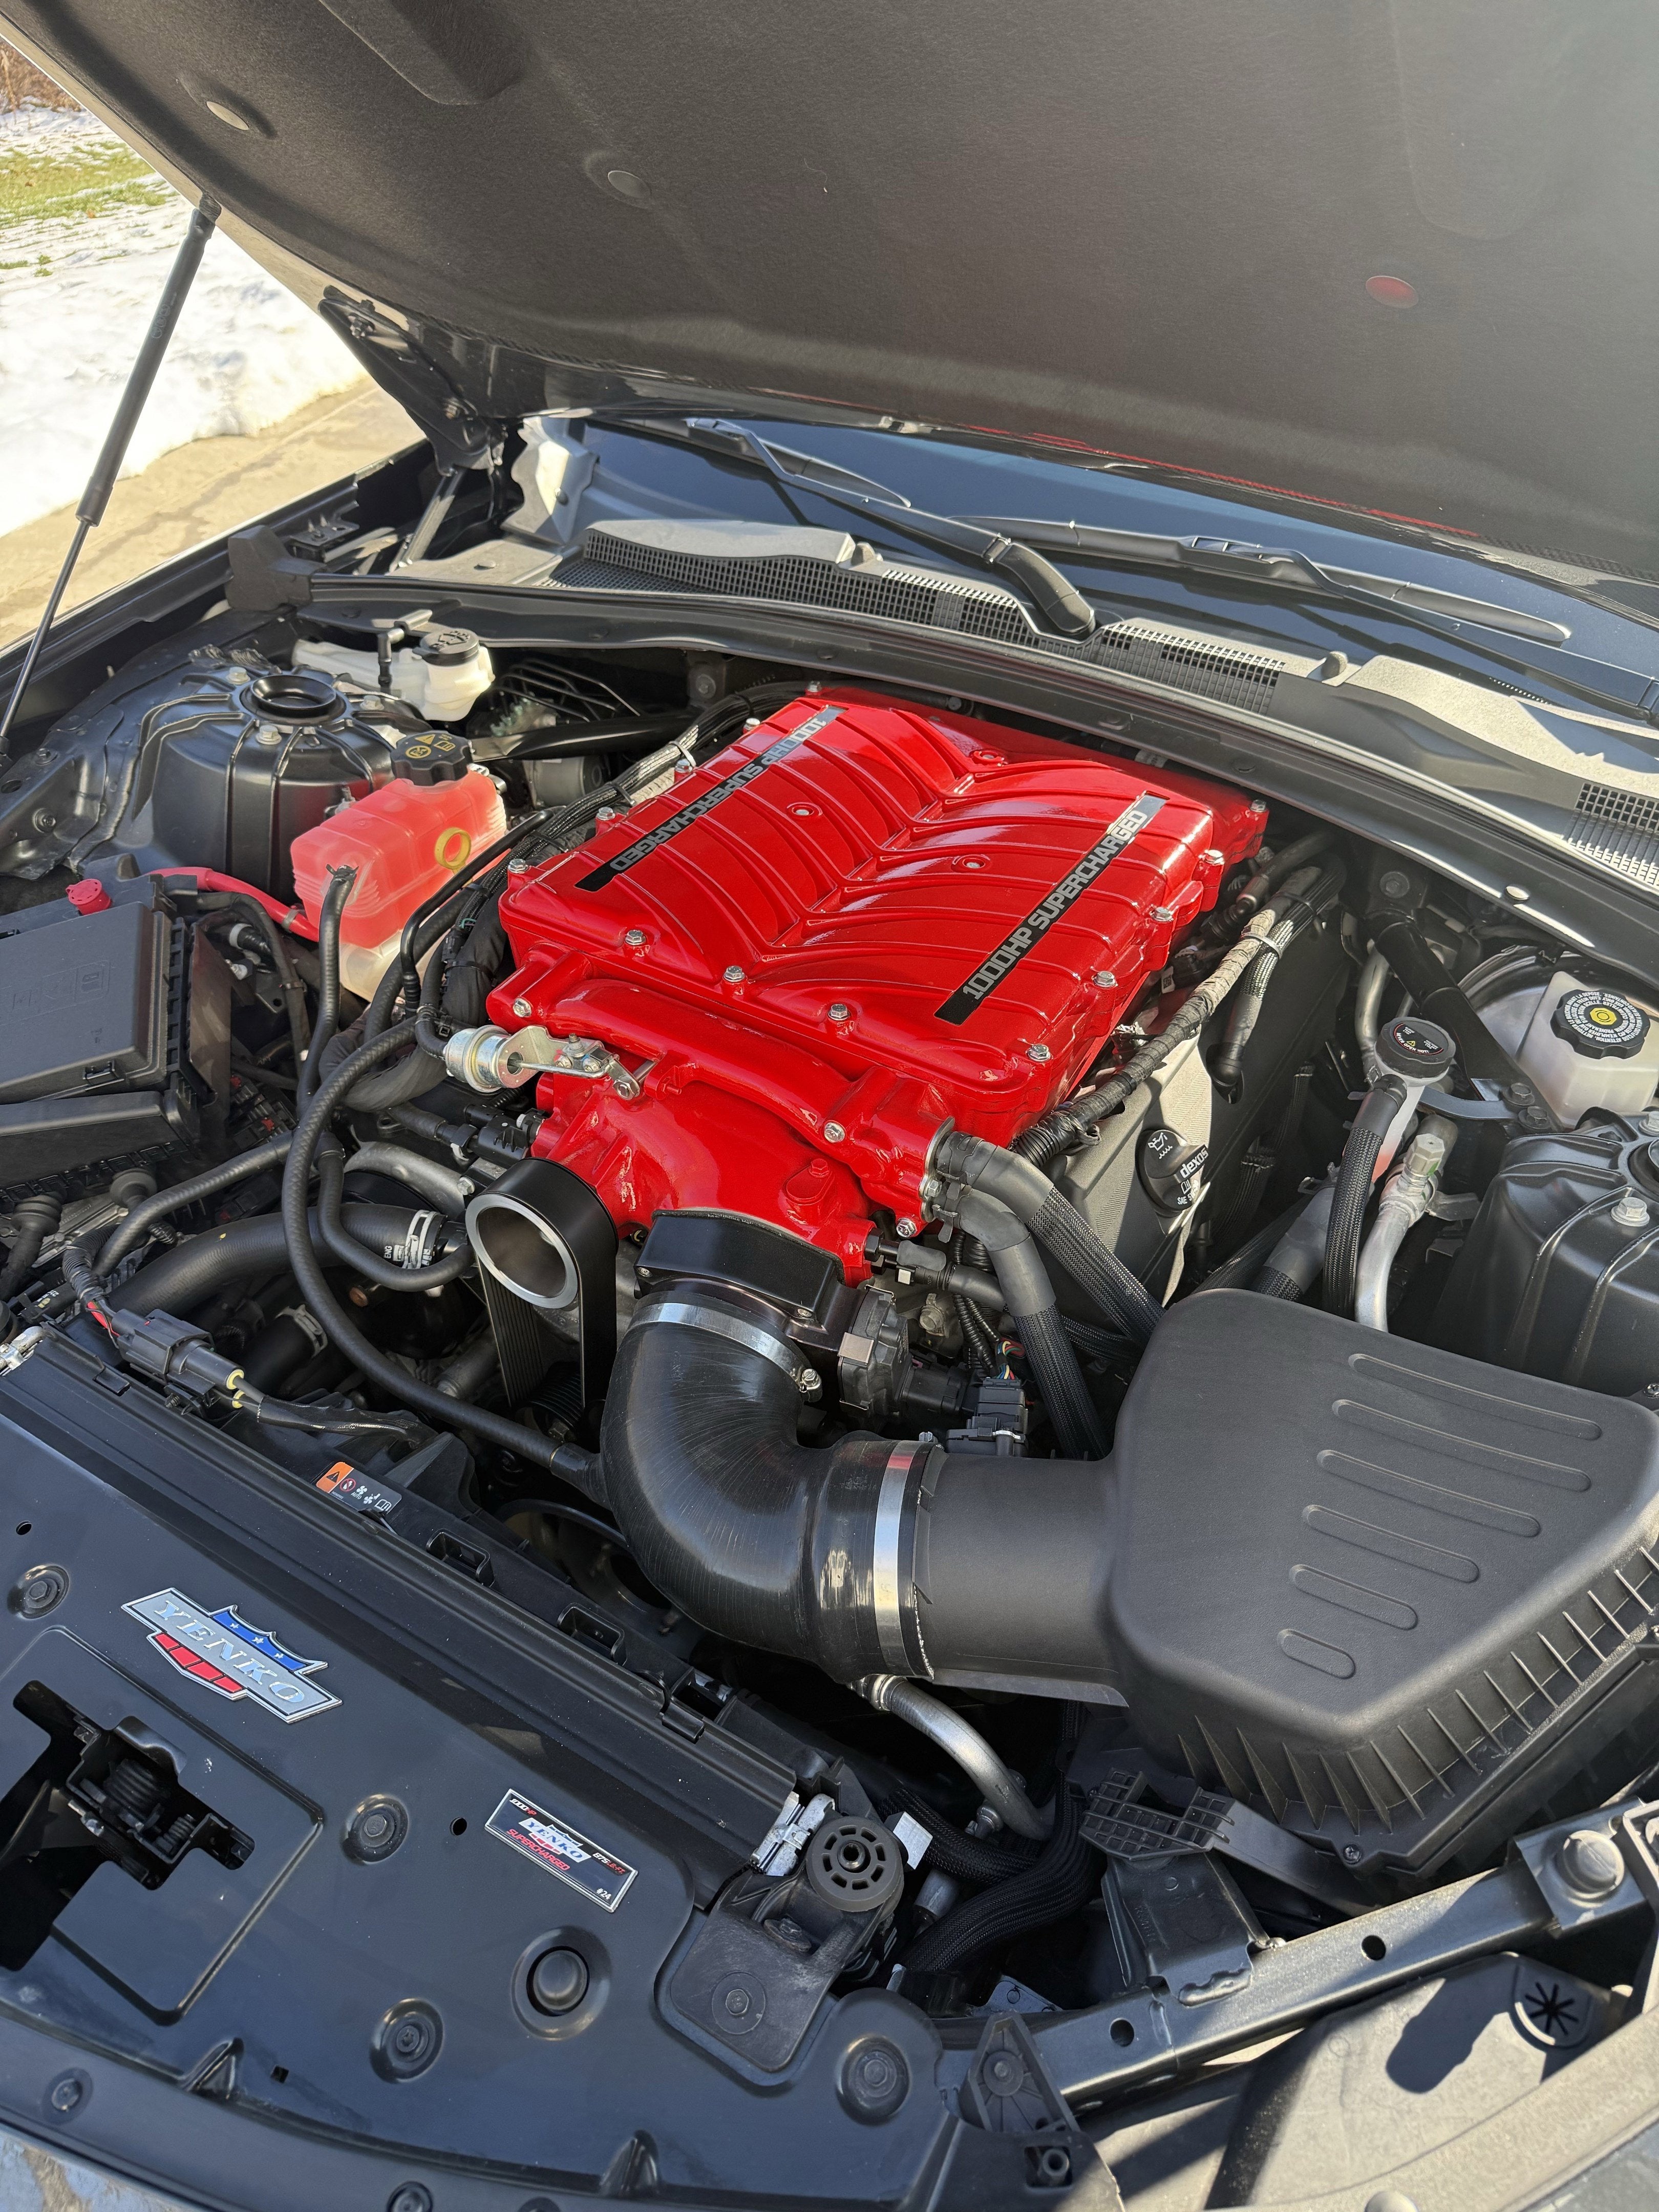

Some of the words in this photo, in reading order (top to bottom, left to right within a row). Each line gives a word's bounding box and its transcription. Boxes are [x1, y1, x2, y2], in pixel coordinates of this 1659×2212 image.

[762, 717, 827, 765] 1000HP
[609, 764, 763, 871] SUPERCHARGED
[963, 926, 1032, 1000] 1000HP
[1027, 810, 1148, 930] SUPERCHARGED
[1403, 1043, 1417, 1051] OPEN
[1180, 1147, 1209, 1178] dexos
[1177, 1196, 1188, 1204] SAE
[384, 1245, 393, 1259] ENG
[154, 1600, 305, 1703] YENKO
[509, 1798, 537, 1816] 1000HP
[506, 1828, 570, 1870] SUPERCHARGED
[526, 1821, 583, 1860] YENKO
[596, 1887, 612, 1900] #24
